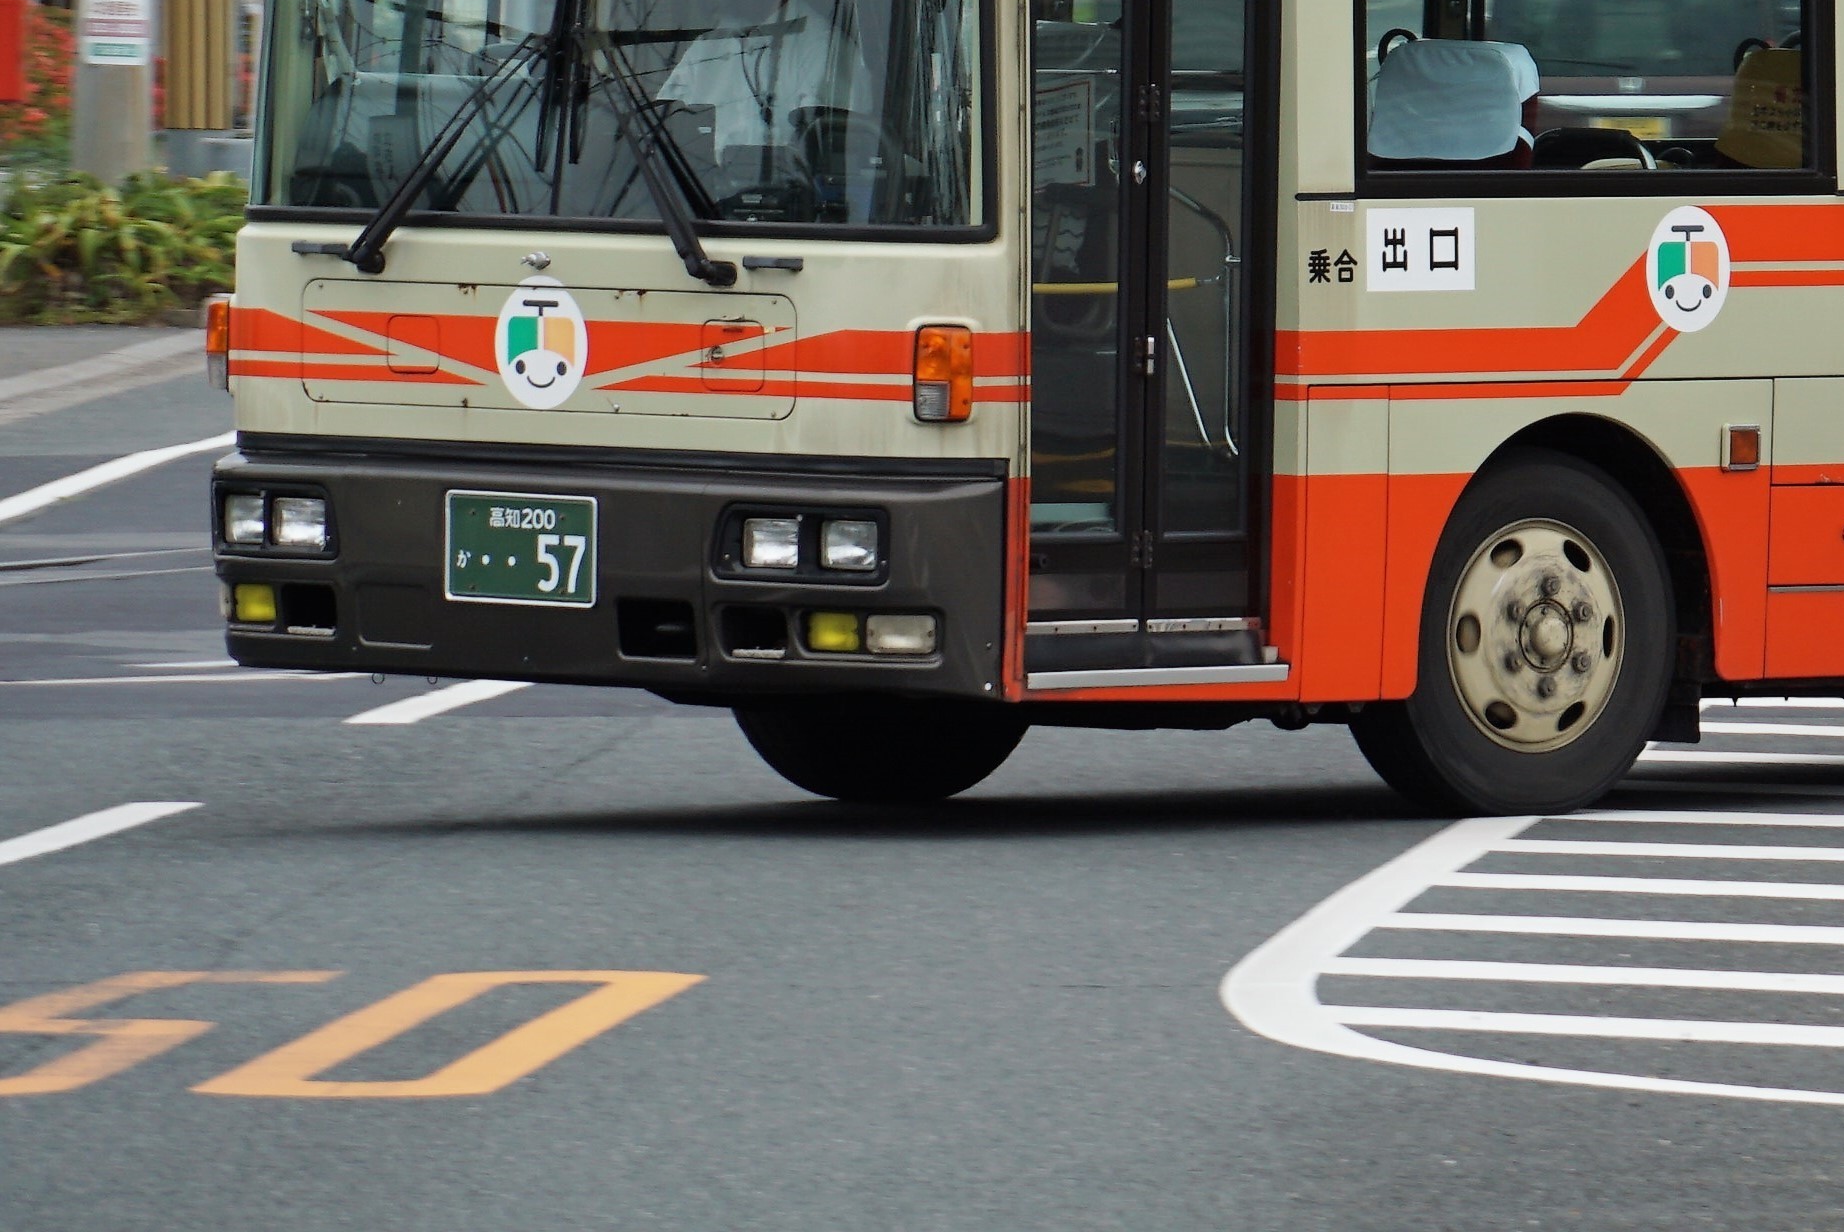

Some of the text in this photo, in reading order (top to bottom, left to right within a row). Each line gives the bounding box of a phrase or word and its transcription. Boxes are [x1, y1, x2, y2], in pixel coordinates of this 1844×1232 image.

[1308, 248, 1358, 284] 乗合
[1382, 227, 1460, 272] 出口
[0, 970, 709, 1097] 50
